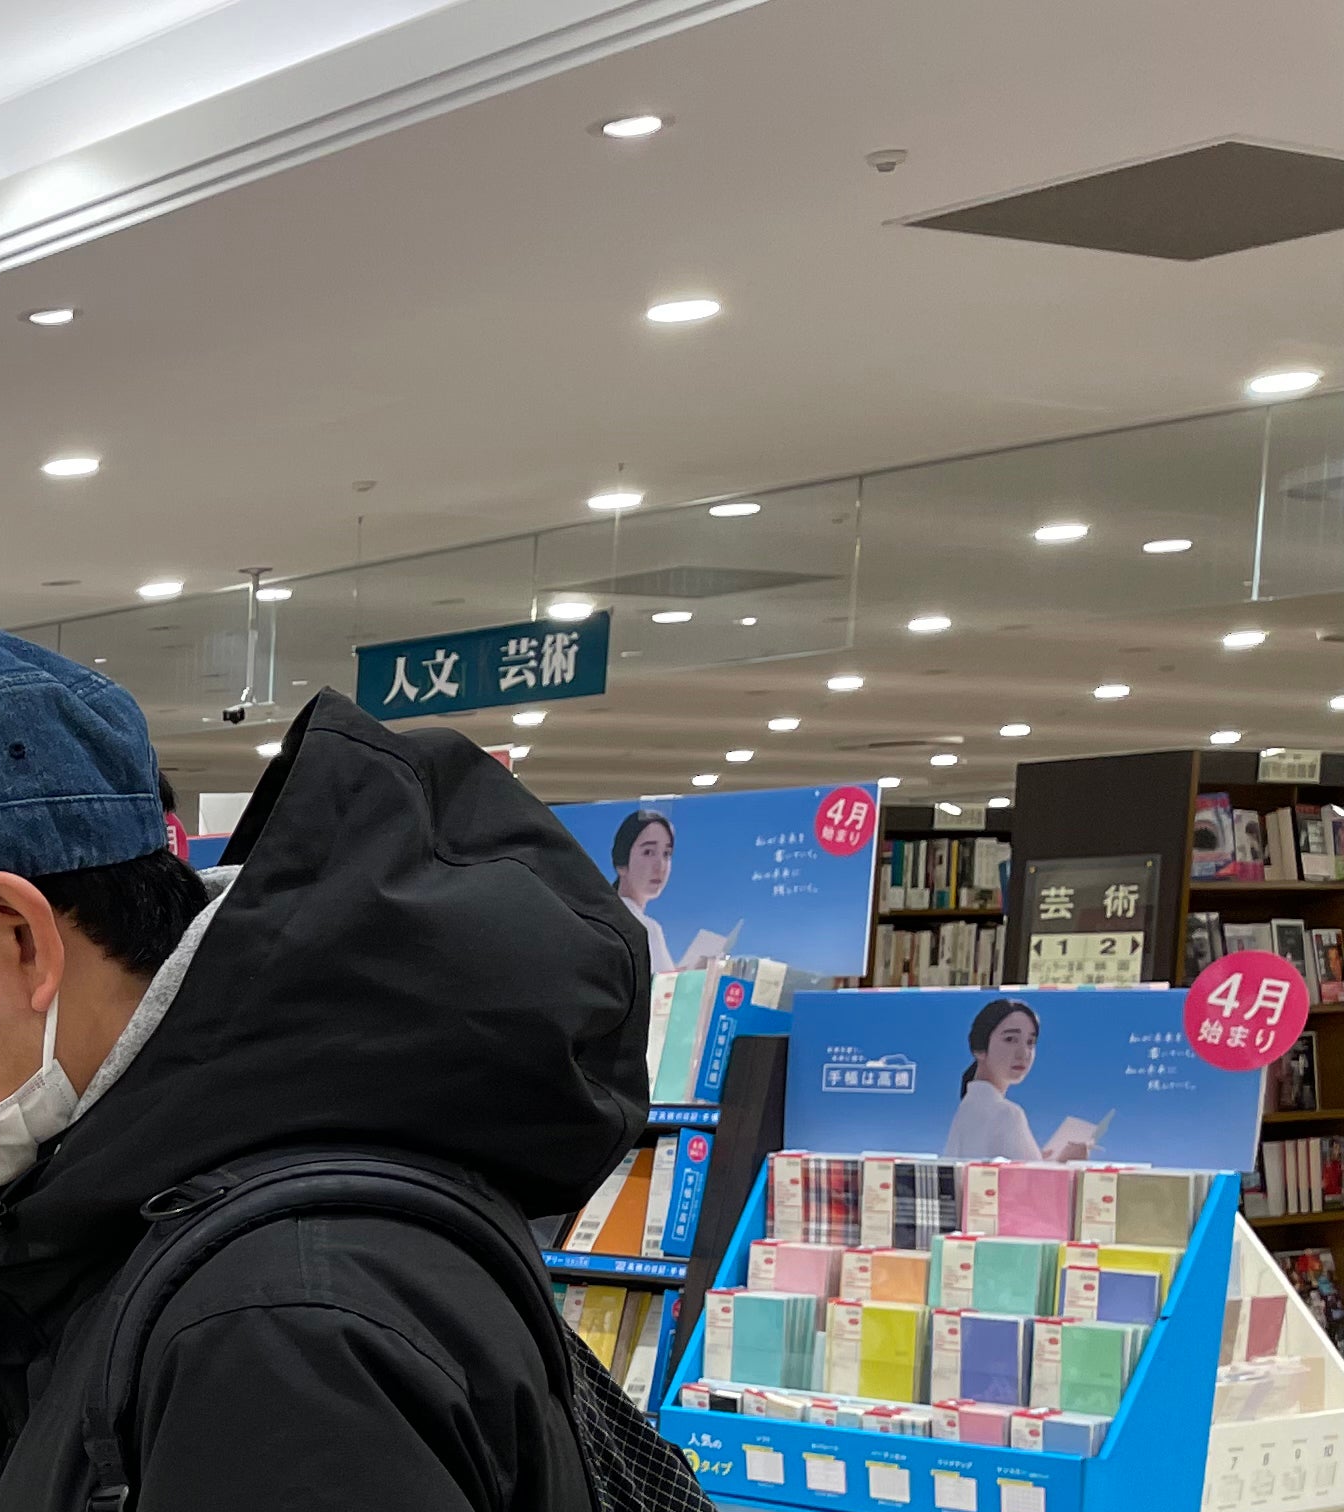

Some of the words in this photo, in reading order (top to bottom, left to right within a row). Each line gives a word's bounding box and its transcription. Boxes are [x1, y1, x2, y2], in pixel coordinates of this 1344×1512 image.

[384, 649, 460, 704] 人文
[499, 632, 579, 692] 芸術
[827, 798, 868, 830] 4月
[1040, 885, 1139, 919] 芸術
[1057, 940, 1067, 955] 1
[1100, 938, 1116, 955] 2
[1207, 972, 1290, 1025] 4月
[1197, 1018, 1275, 1054] 始まり
[688, 1432, 722, 1449] 人気の
